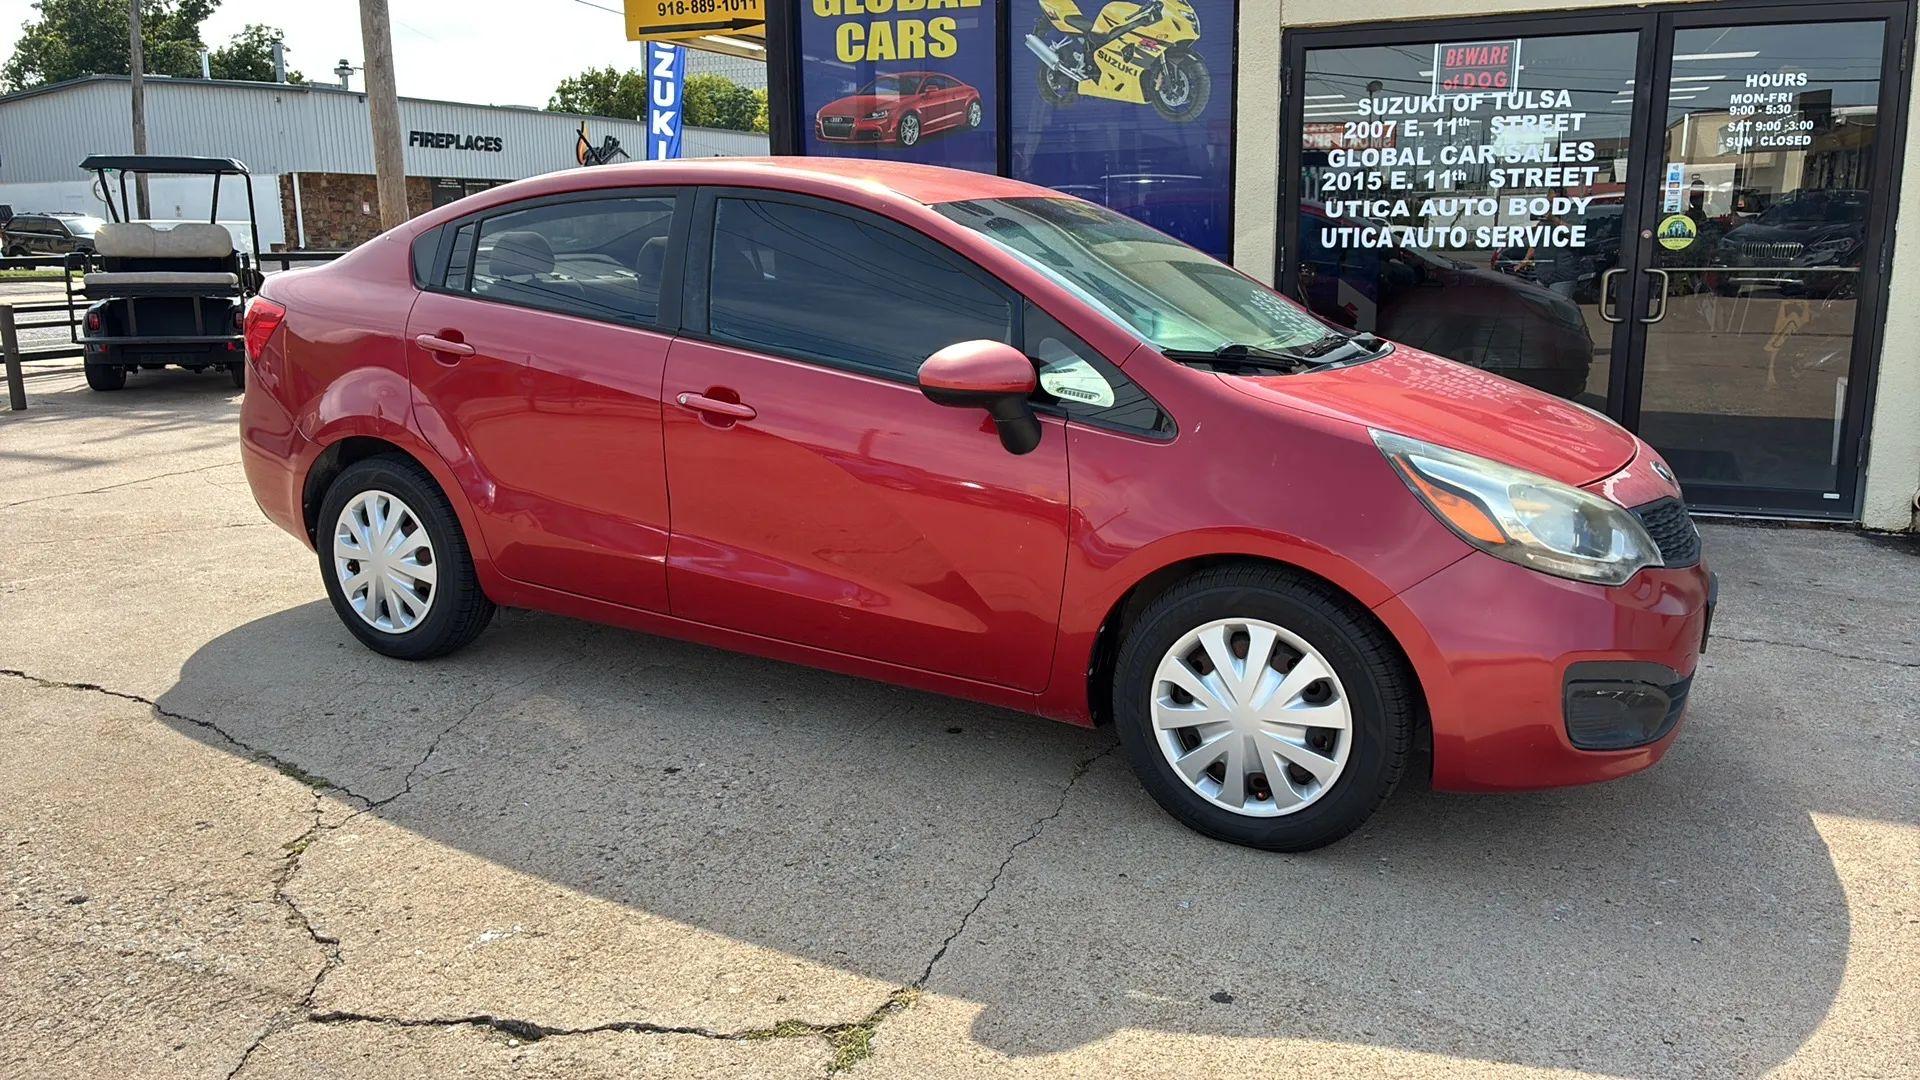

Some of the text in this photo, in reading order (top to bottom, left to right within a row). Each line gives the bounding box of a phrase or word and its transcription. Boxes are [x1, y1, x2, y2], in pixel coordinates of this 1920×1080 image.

[658, 0, 757, 16] 918-889-1011
[836, 17, 958, 63] CARS
[1097, 49, 1138, 77] SUZUKI
[1445, 46, 1509, 67] BEWARE
[1443, 71, 1508, 90] of DOG
[1746, 73, 1807, 87] HOURS
[652, 42, 676, 160] ZUKI
[1357, 89, 1572, 116] SUZUKI OF TULSA
[1730, 92, 1793, 104] MON-FRI
[1729, 105, 1755, 116] 9:00
[1766, 104, 1791, 115] 5:30
[1343, 120, 1397, 139] 2007
[1404, 119, 1424, 137] E.
[1433, 116, 1470, 136] 11th
[1490, 113, 1586, 134] STREET
[1728, 121, 1752, 132] SAT
[1756, 121, 1781, 131] 9:00
[409, 130, 502, 152] FIREPLACES
[1726, 135, 1811, 147] SUN CLOSED
[1328, 141, 1595, 167] GLOBAL CAR SALES
[1322, 166, 1599, 191] 2015 E. 11th STREET
[1325, 197, 1595, 218] UTICA AUTO BODY
[1321, 225, 1586, 249] UTICA AUTO SERVICE
